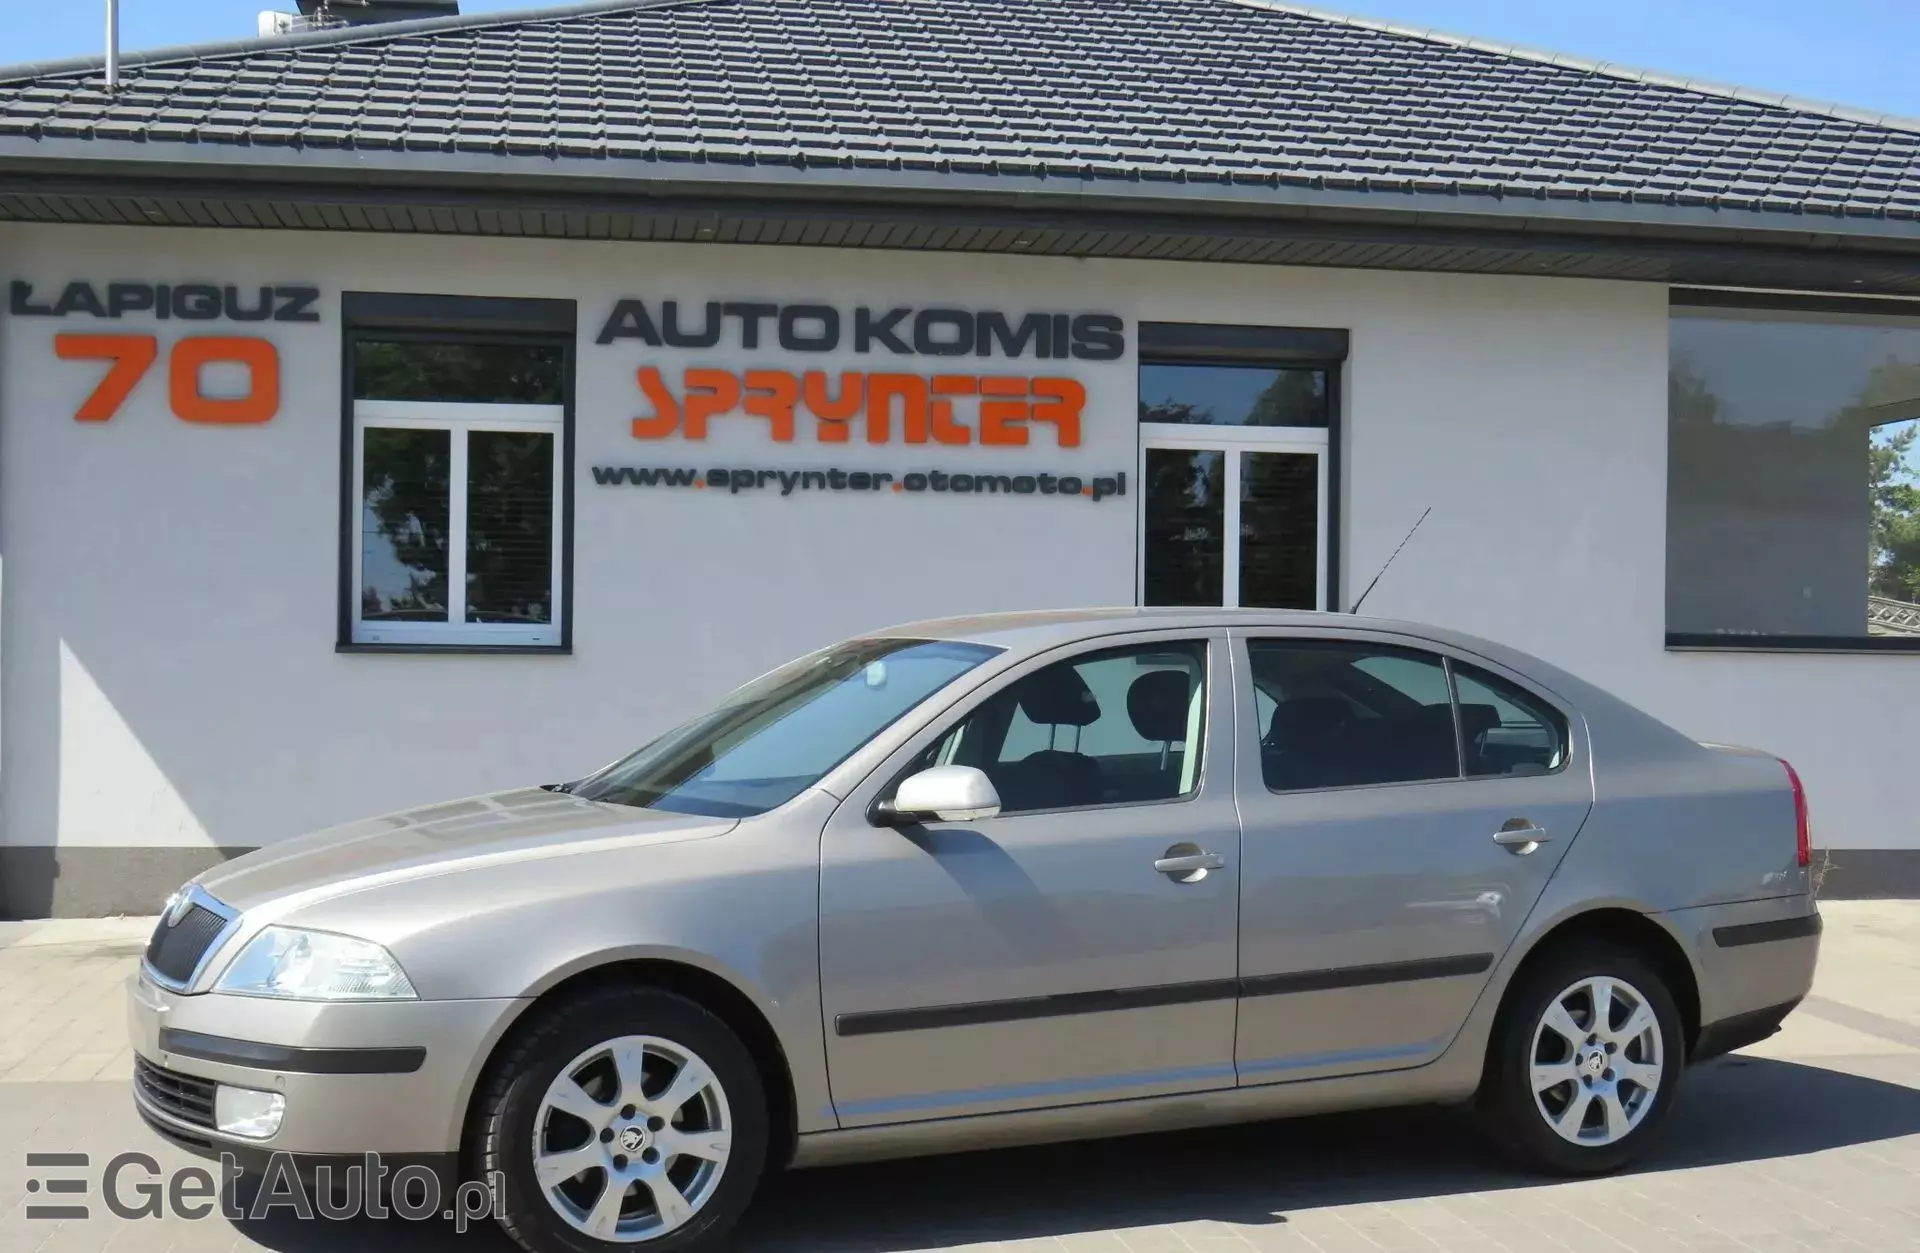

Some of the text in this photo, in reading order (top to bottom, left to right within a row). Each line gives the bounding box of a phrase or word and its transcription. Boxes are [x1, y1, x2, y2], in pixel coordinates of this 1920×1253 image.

[11, 280, 320, 322] ŁAPIGUZ
[595, 298, 1126, 361] AUTO KOMIS
[54, 334, 280, 424] 70
[631, 365, 1087, 447] SPRYNTER
[592, 466, 1127, 502] www.sprynter.otomoto.pl
